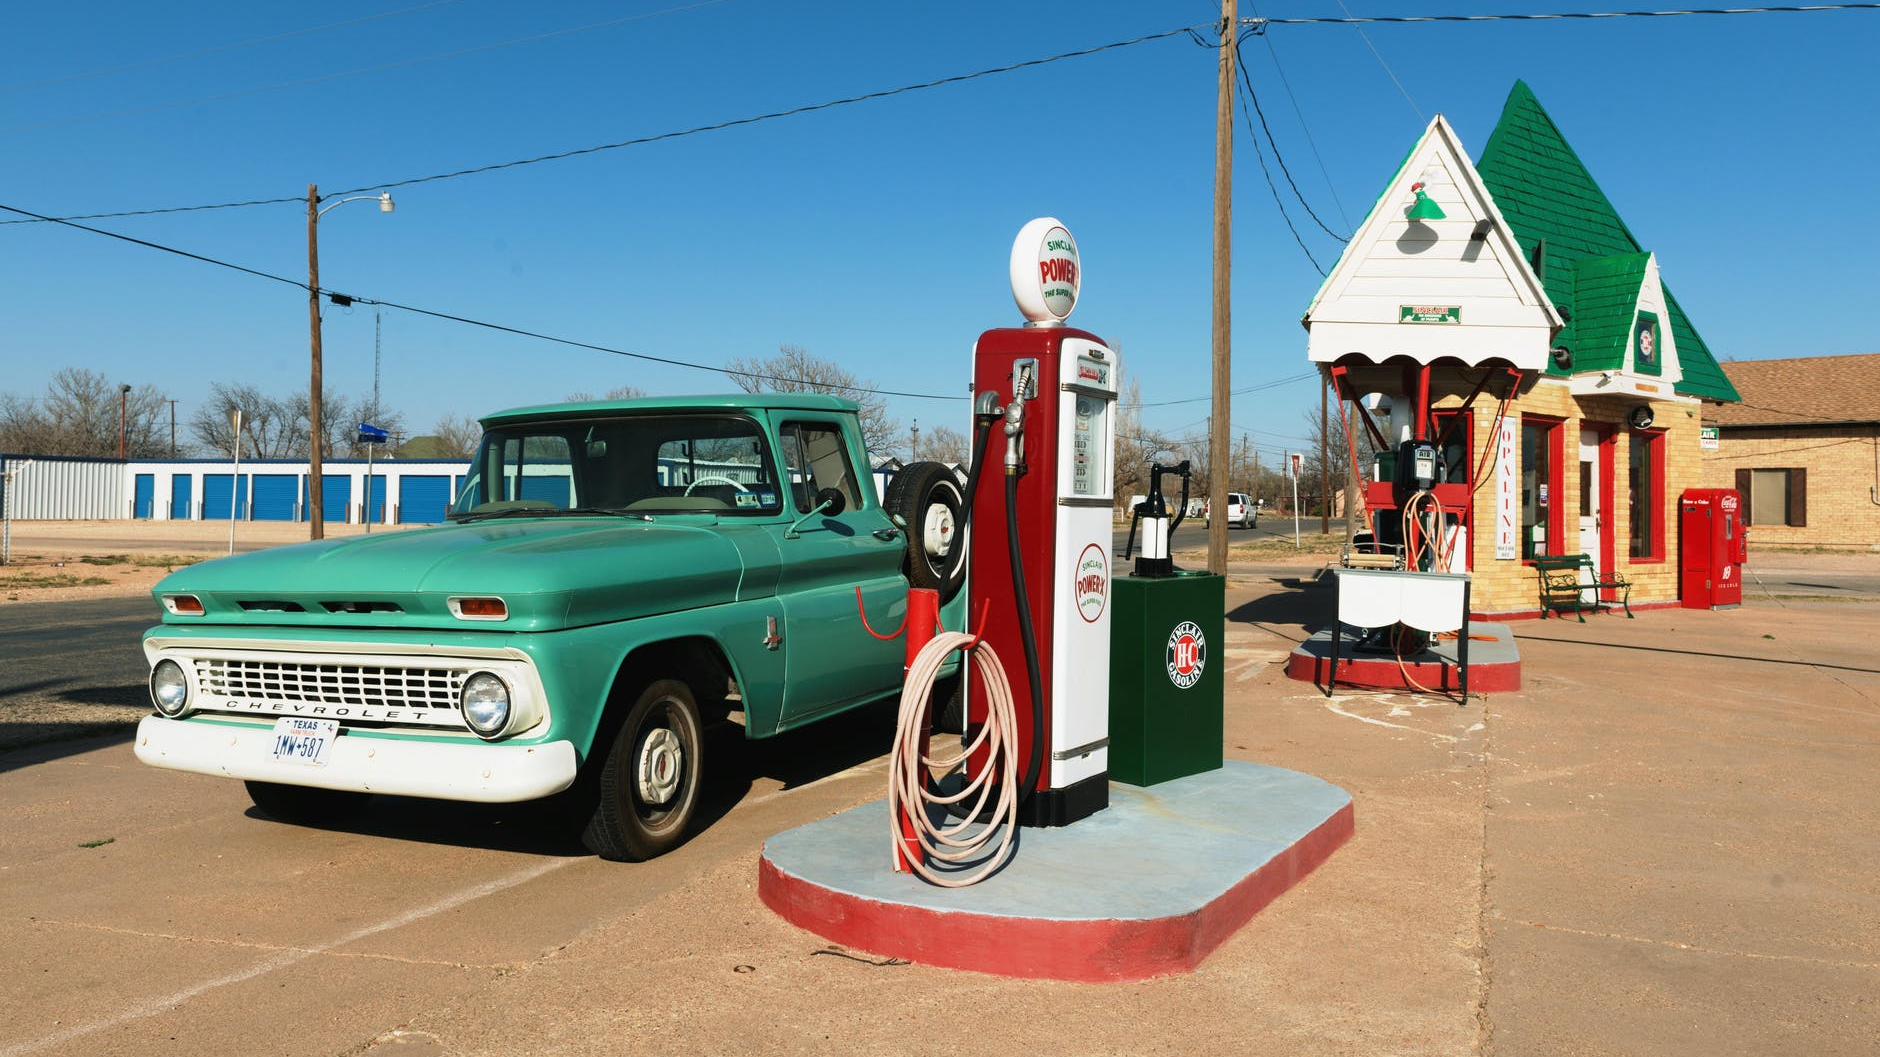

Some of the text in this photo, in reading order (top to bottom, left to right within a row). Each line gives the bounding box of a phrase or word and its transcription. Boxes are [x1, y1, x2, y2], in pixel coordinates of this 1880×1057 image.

[1047, 240, 1076, 255] SINCLA
[1044, 289, 1055, 298] THE
[1056, 288, 1071, 298] SUPER
[1502, 430, 1512, 545] OPALINE
[1082, 560, 1103, 571] SINCLAIR
[1169, 623, 1204, 650] SINCLAIR
[1168, 658, 1204, 687] GASOLINE
[226, 700, 428, 720] CHEVROLET
[293, 720, 318, 730] TEXAS
